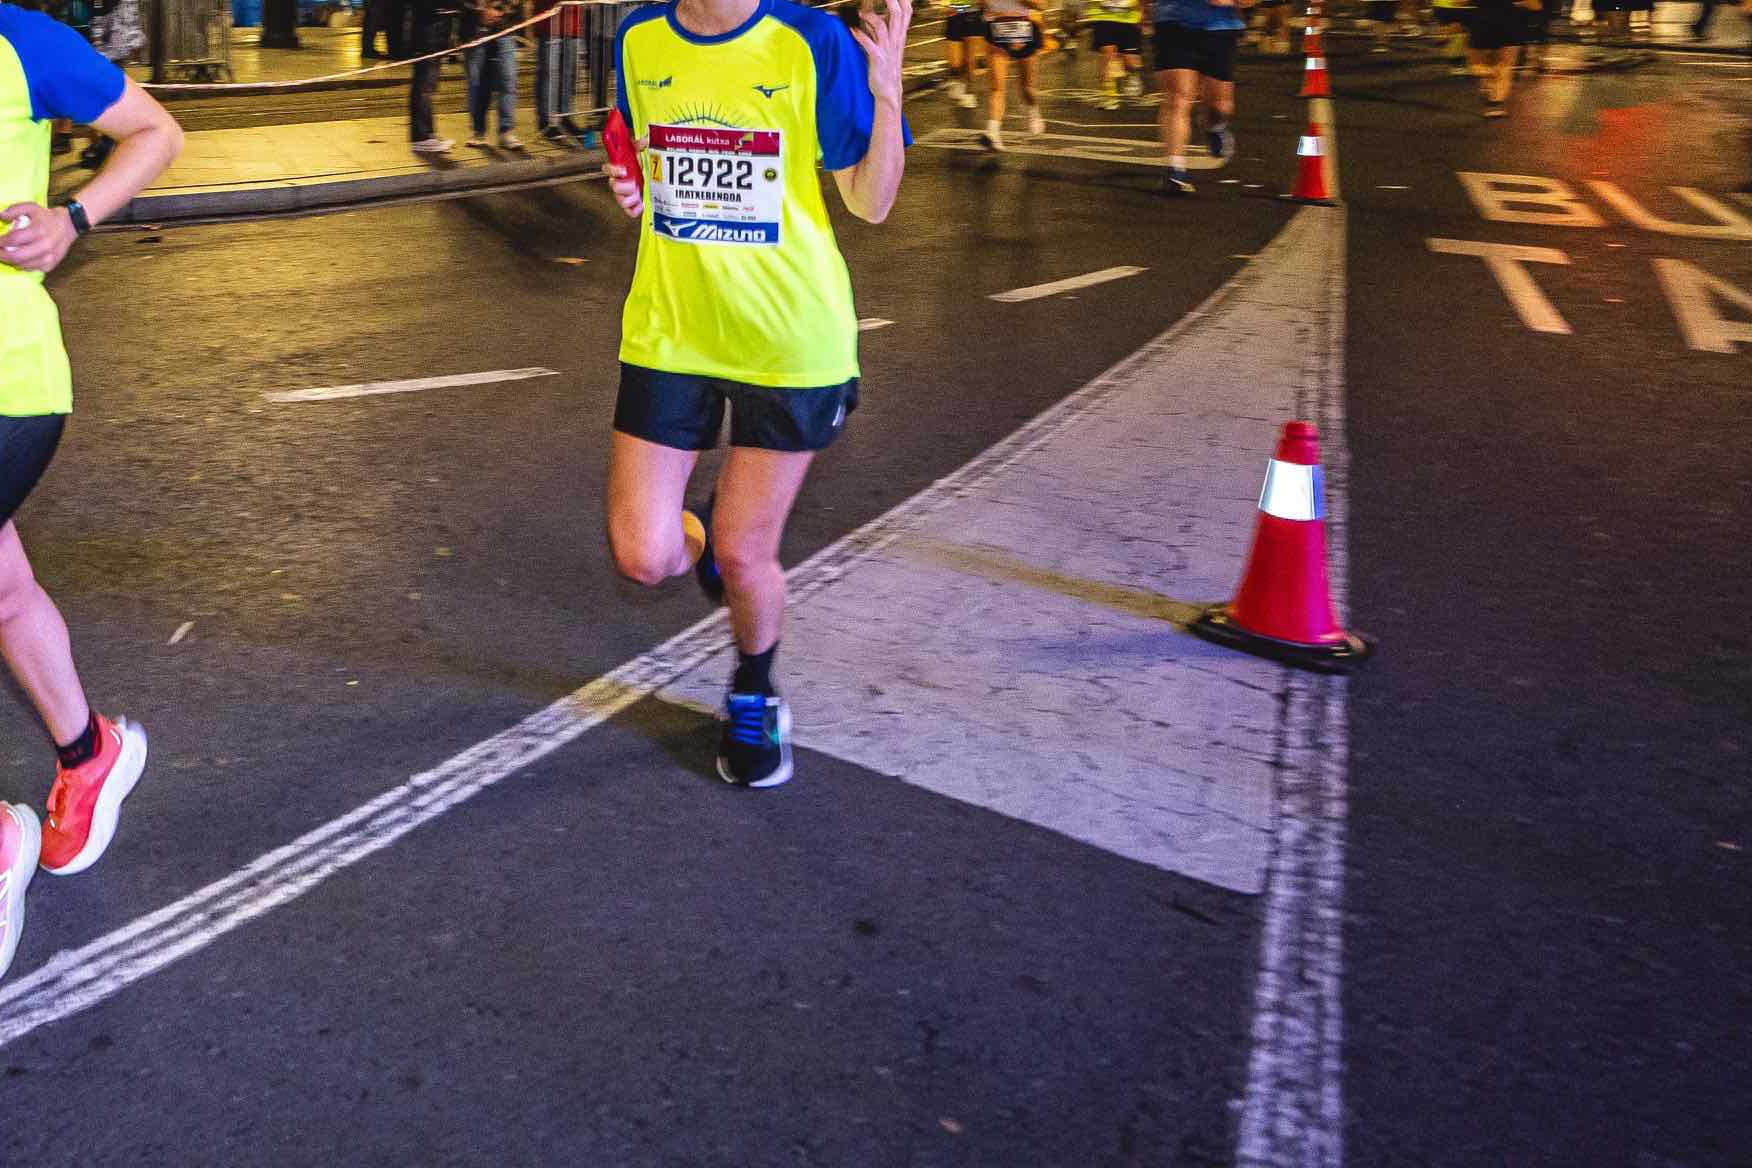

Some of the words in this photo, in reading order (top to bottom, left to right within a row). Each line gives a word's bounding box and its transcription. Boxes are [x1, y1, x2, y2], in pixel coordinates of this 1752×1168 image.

[666, 156, 753, 190] 12922
[1455, 171, 1752, 241] BU
[689, 223, 766, 242] MIZUNO
